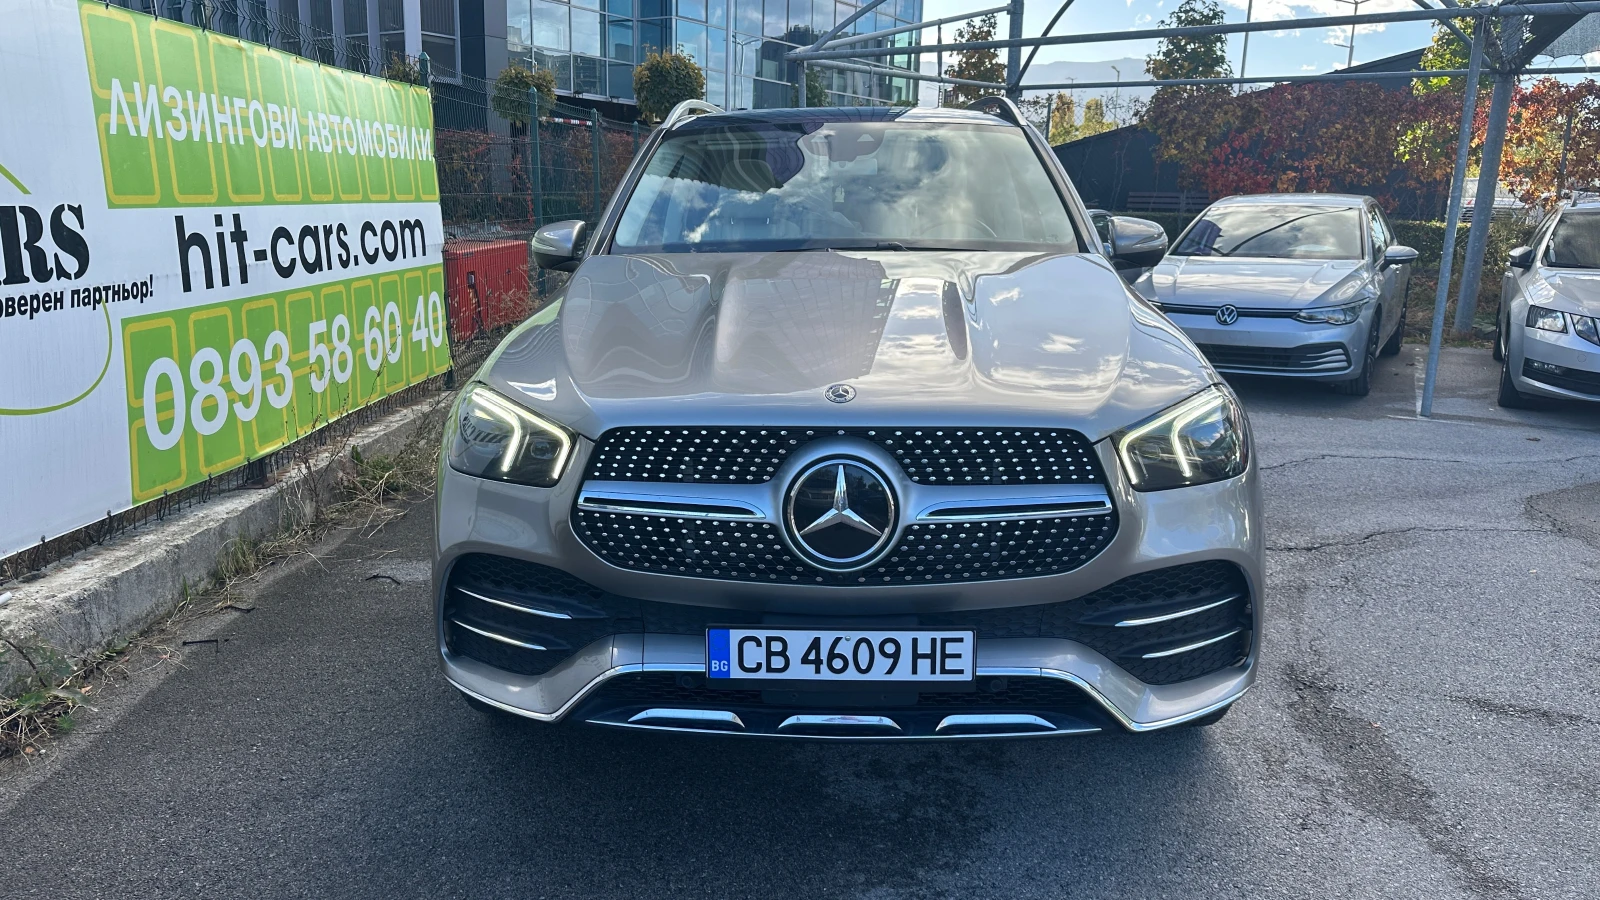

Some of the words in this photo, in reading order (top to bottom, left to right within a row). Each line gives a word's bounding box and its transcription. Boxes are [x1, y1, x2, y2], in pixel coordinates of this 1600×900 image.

[109, 78, 302, 150] ЛИЗИНГОВИ
[307, 110, 433, 162] АВТОМОБИЛИ
[0, 203, 90, 285] RS
[174, 212, 427, 293] hit-cars.com
[70, 274, 154, 311] партньор!
[143, 330, 294, 451] 0893
[308, 313, 353, 393] 58
[363, 301, 402, 371] 60
[411, 291, 443, 352] 40
[711, 659, 729, 672] BG
[737, 635, 791, 674] CB
[800, 636, 901, 675] 4609
[911, 637, 965, 675] HE
